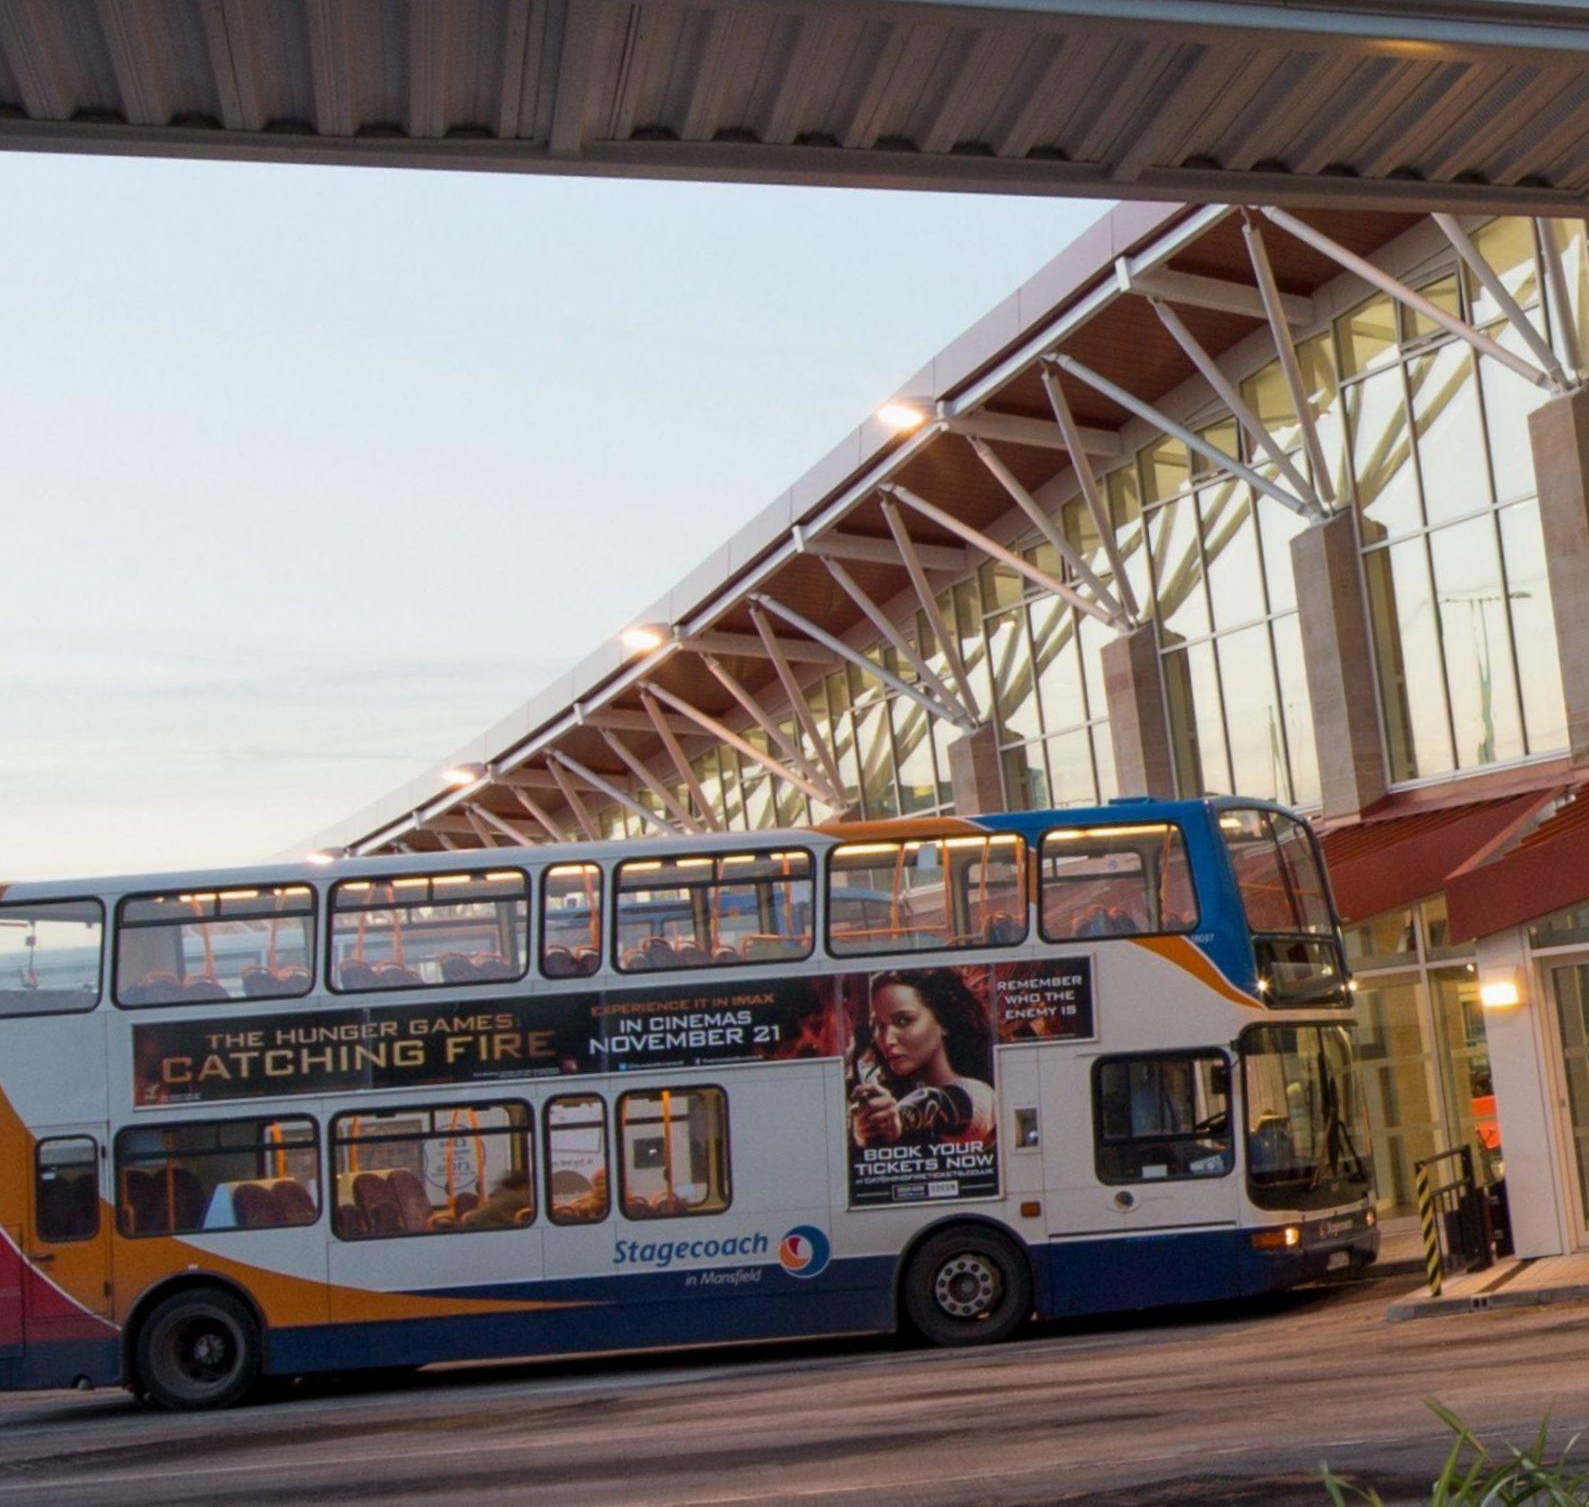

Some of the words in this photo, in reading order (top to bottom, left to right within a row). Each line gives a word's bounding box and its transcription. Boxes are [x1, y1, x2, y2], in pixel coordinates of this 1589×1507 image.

[997, 974, 1083, 992] REMEMBER
[590, 998, 690, 1018] EXPERIENCE
[694, 997, 710, 1010] IT
[712, 996, 728, 1008] IN
[732, 993, 775, 1007] IMAX
[1004, 992, 1041, 1005] WHO
[1044, 990, 1076, 1002] THE
[619, 1018, 643, 1034] IN
[649, 1010, 753, 1032] CINEMAS
[1004, 1006, 1057, 1021] ENEMY
[1061, 1004, 1077, 1016] IS
[206, 1030, 265, 1050] THE
[275, 1021, 398, 1046] HUNGER
[588, 1027, 744, 1056] NOVEMBER
[752, 1024, 781, 1043] 21
[161, 1039, 426, 1083] CATCHING
[446, 1030, 557, 1064] FIRE
[863, 1144, 922, 1162] BOOK
[928, 1140, 984, 1156] YOUR
[854, 1157, 939, 1176] TICKETS
[945, 1153, 994, 1169] NOW
[612, 1231, 769, 1268] Stagecoach
[684, 1274, 697, 1287] in
[700, 1268, 763, 1287] Mansfield
